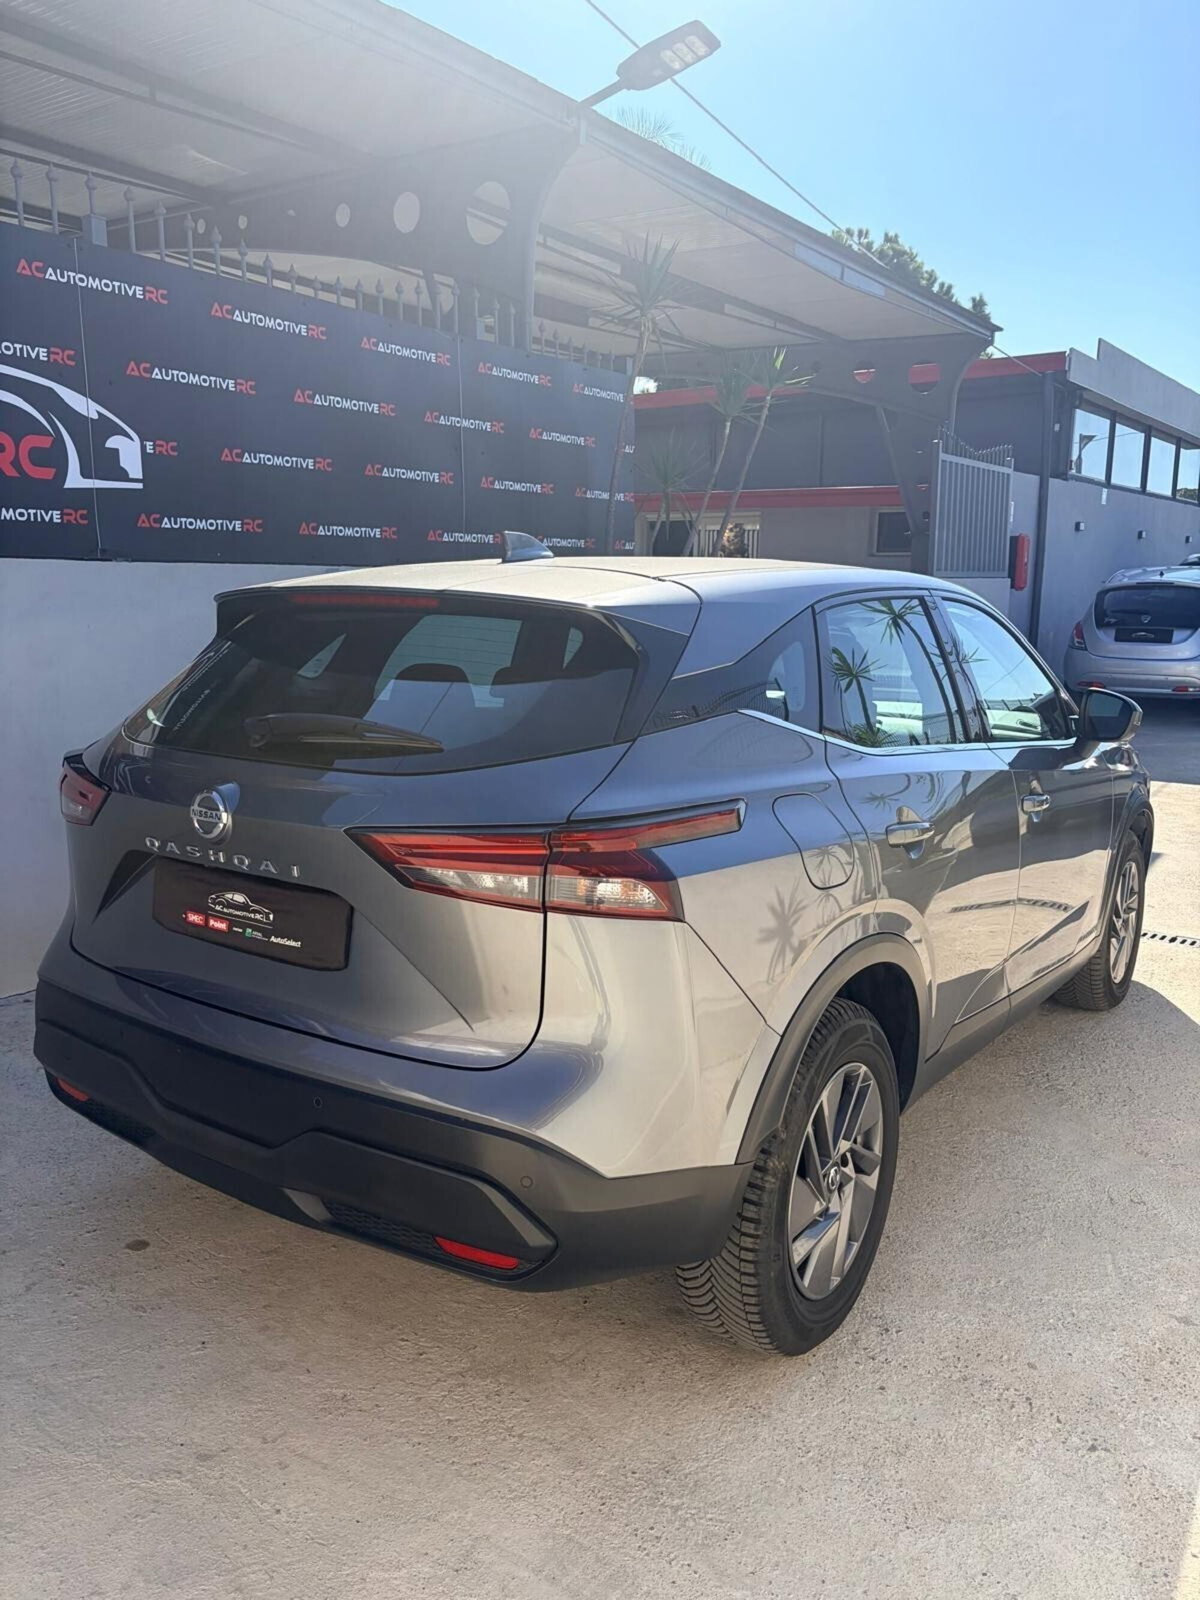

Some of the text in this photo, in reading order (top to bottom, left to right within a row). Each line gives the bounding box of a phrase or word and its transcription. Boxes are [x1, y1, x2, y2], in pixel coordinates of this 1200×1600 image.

[0, 342, 76, 366] OTIVERC
[144, 440, 178, 457] ERC
[0, 507, 89, 525] MOTIVERC
[191, 807, 221, 822] NISSAN
[145, 837, 300, 878] QASHQAI
[270, 935, 301, 948] AutoSelect
